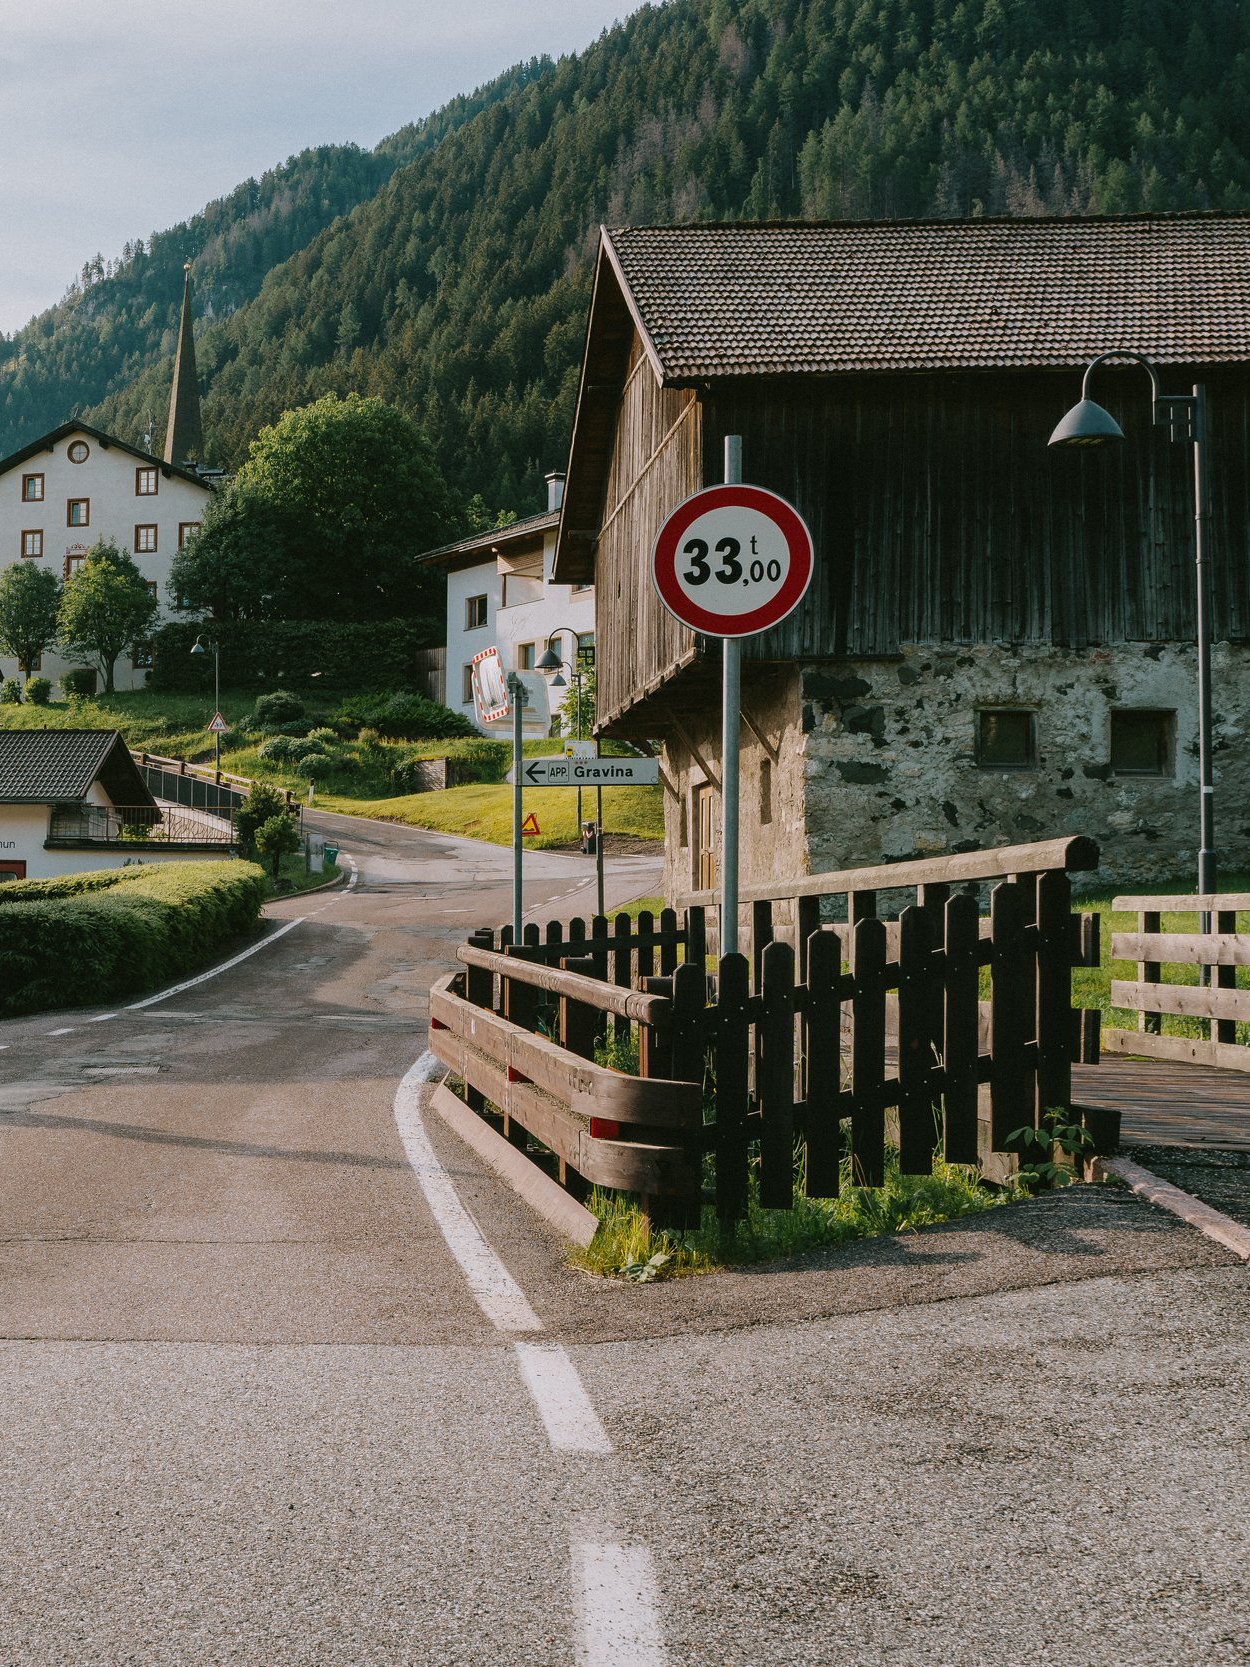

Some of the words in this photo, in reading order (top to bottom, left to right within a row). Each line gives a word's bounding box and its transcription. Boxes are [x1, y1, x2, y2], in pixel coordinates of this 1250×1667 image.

[750, 535, 759, 555] t
[550, 767, 568, 778] APP.
[574, 765, 634, 778] Gravina
